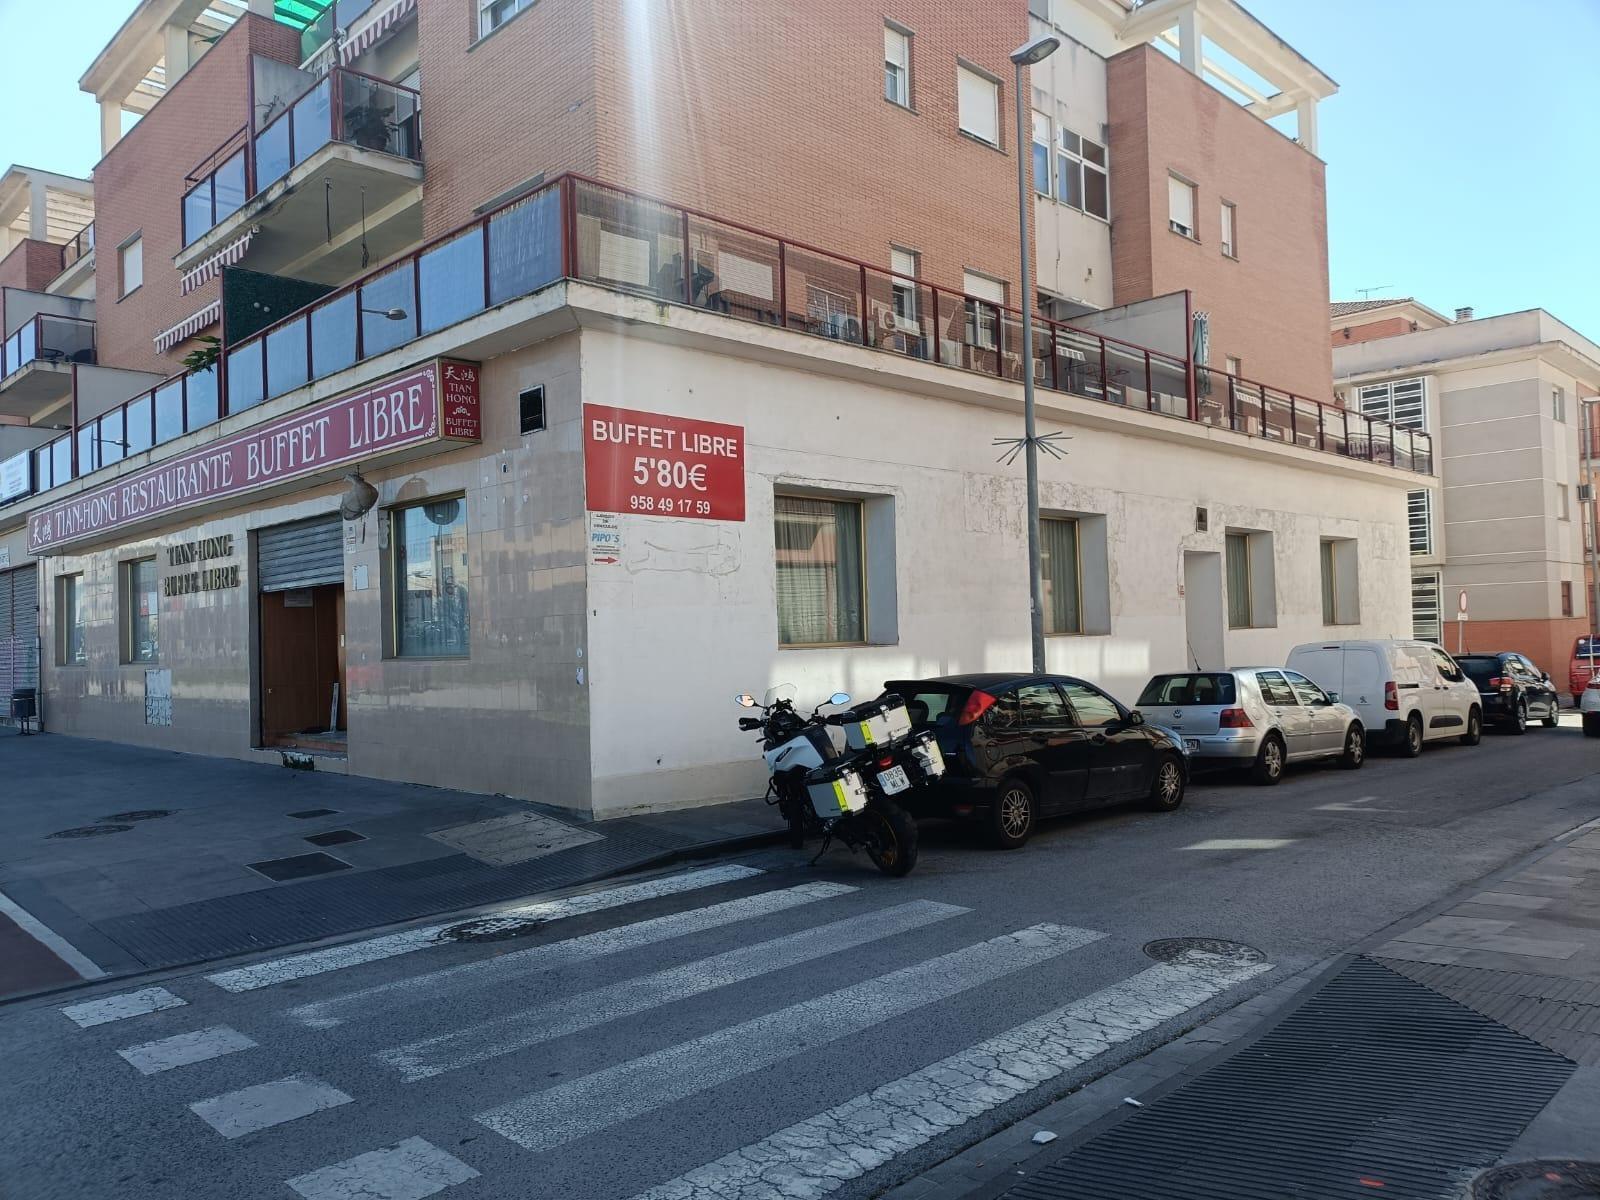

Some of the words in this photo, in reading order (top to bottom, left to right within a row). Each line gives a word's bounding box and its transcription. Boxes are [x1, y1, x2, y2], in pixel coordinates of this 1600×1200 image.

[449, 383, 472, 393] TIAN
[446, 393, 476, 405] HONG
[446, 417, 478, 427] BUFFET
[450, 427, 475, 437] LIBRE
[592, 419, 676, 450] BUFFET
[682, 431, 738, 458] LIBRE
[55, 492, 118, 538] TIAN-HONG
[122, 451, 233, 517] RESTAURANTE
[247, 416, 330, 480] BUFFET
[348, 383, 425, 449] LIBRE
[630, 495, 654, 511] 958
[657, 498, 674, 512] 49
[678, 500, 692, 513] 17
[696, 501, 711, 515] 59
[167, 534, 233, 566] TIAN-HONG
[884, 766, 904, 782] 0835
